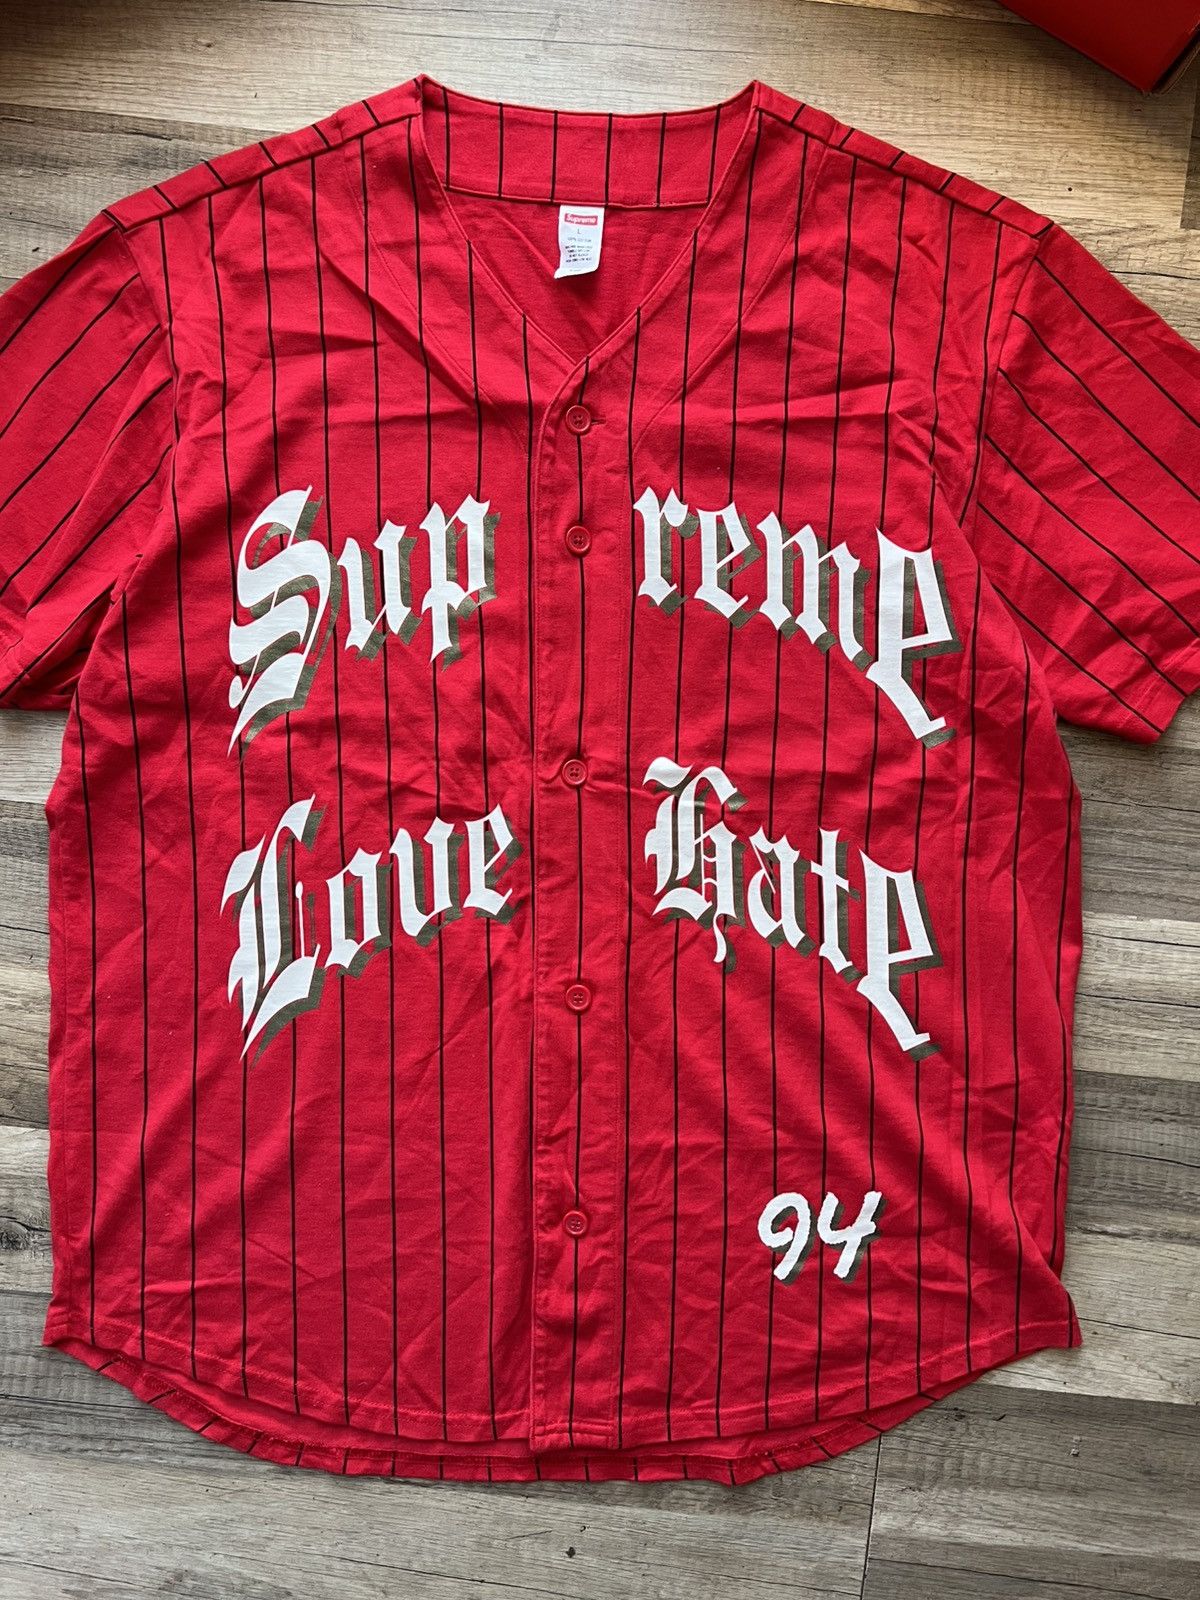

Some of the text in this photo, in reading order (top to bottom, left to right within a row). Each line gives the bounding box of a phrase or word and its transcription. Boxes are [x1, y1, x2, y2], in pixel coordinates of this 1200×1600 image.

[565, 214, 597, 224] Supreme
[220, 757, 942, 1067] Love Hate
[758, 1191, 886, 1284] 94
